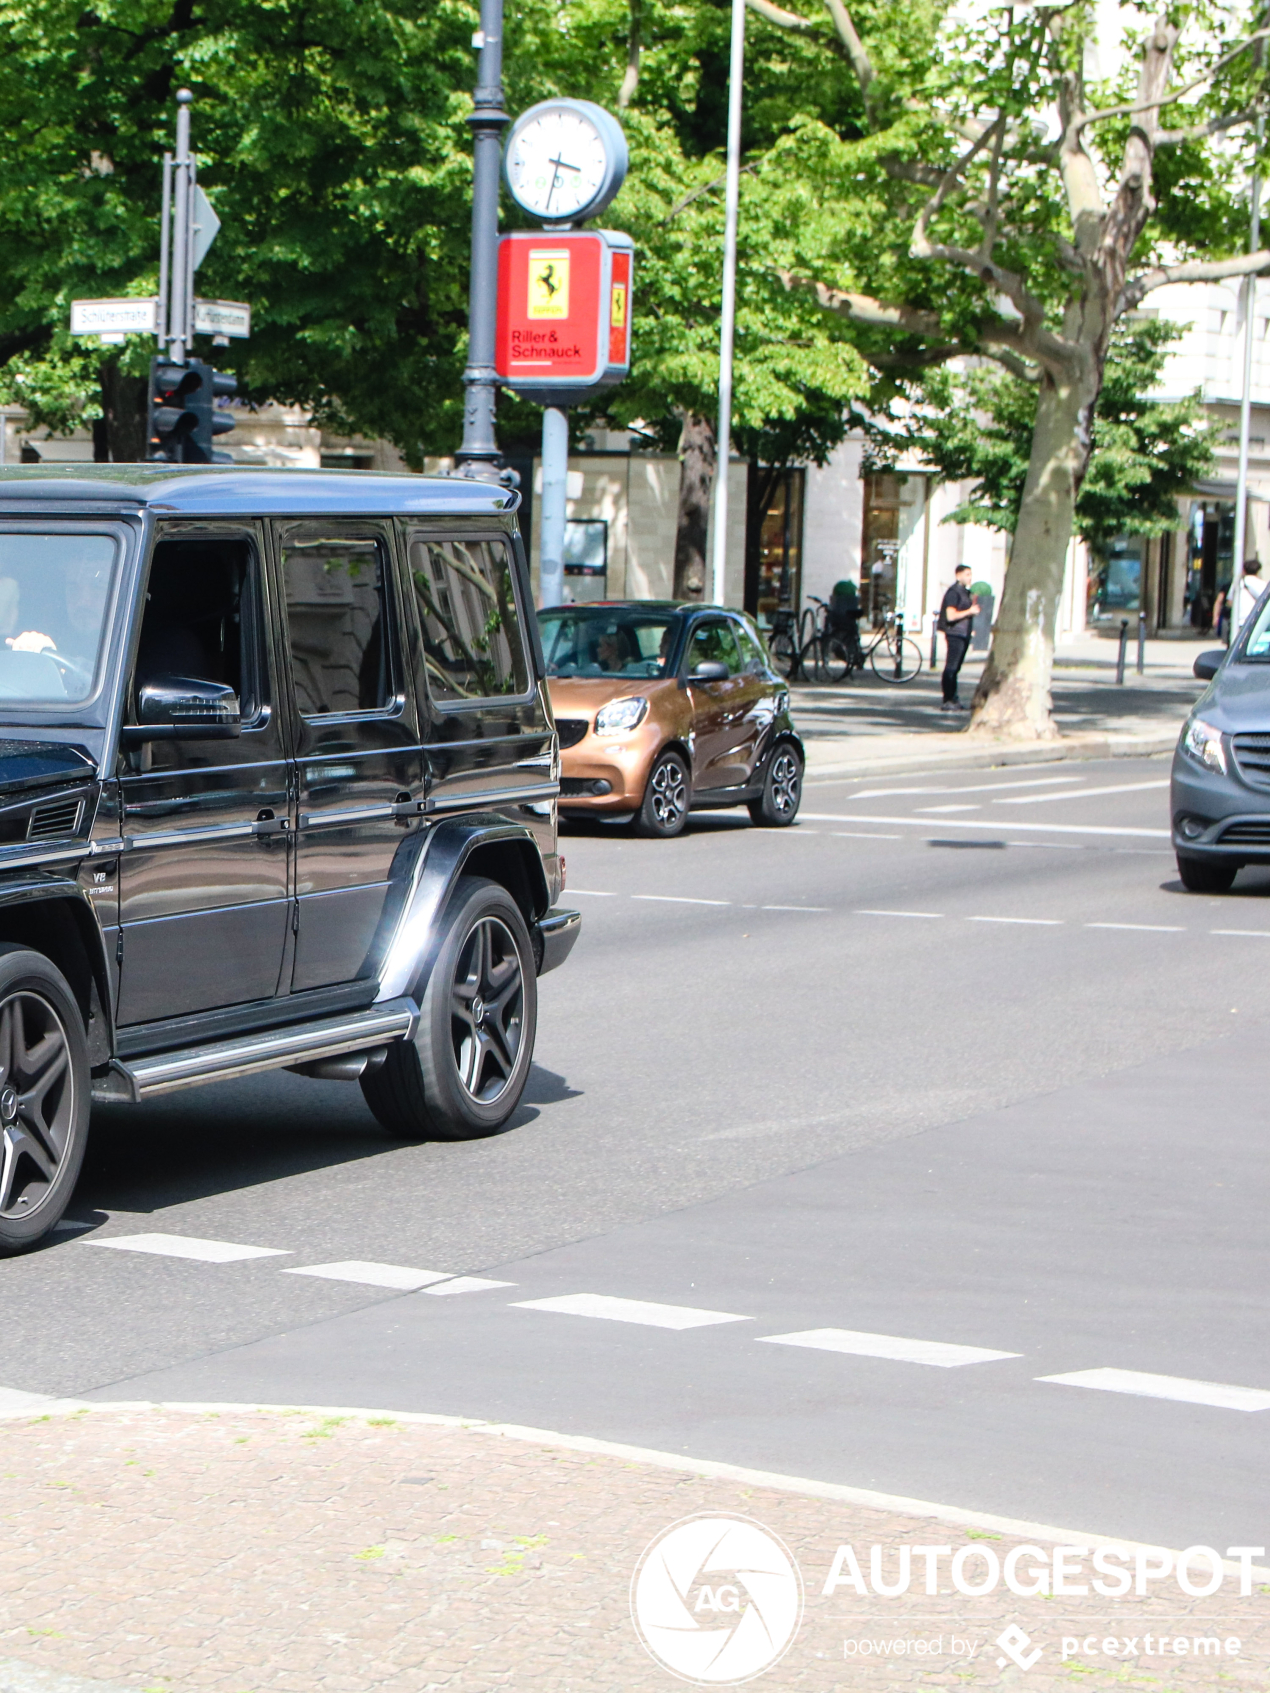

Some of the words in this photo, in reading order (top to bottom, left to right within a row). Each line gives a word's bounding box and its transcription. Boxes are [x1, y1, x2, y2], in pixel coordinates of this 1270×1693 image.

[512, 330, 546, 343] Riller
[548, 330, 558, 343] &
[512, 345, 581, 358] Schnauck
